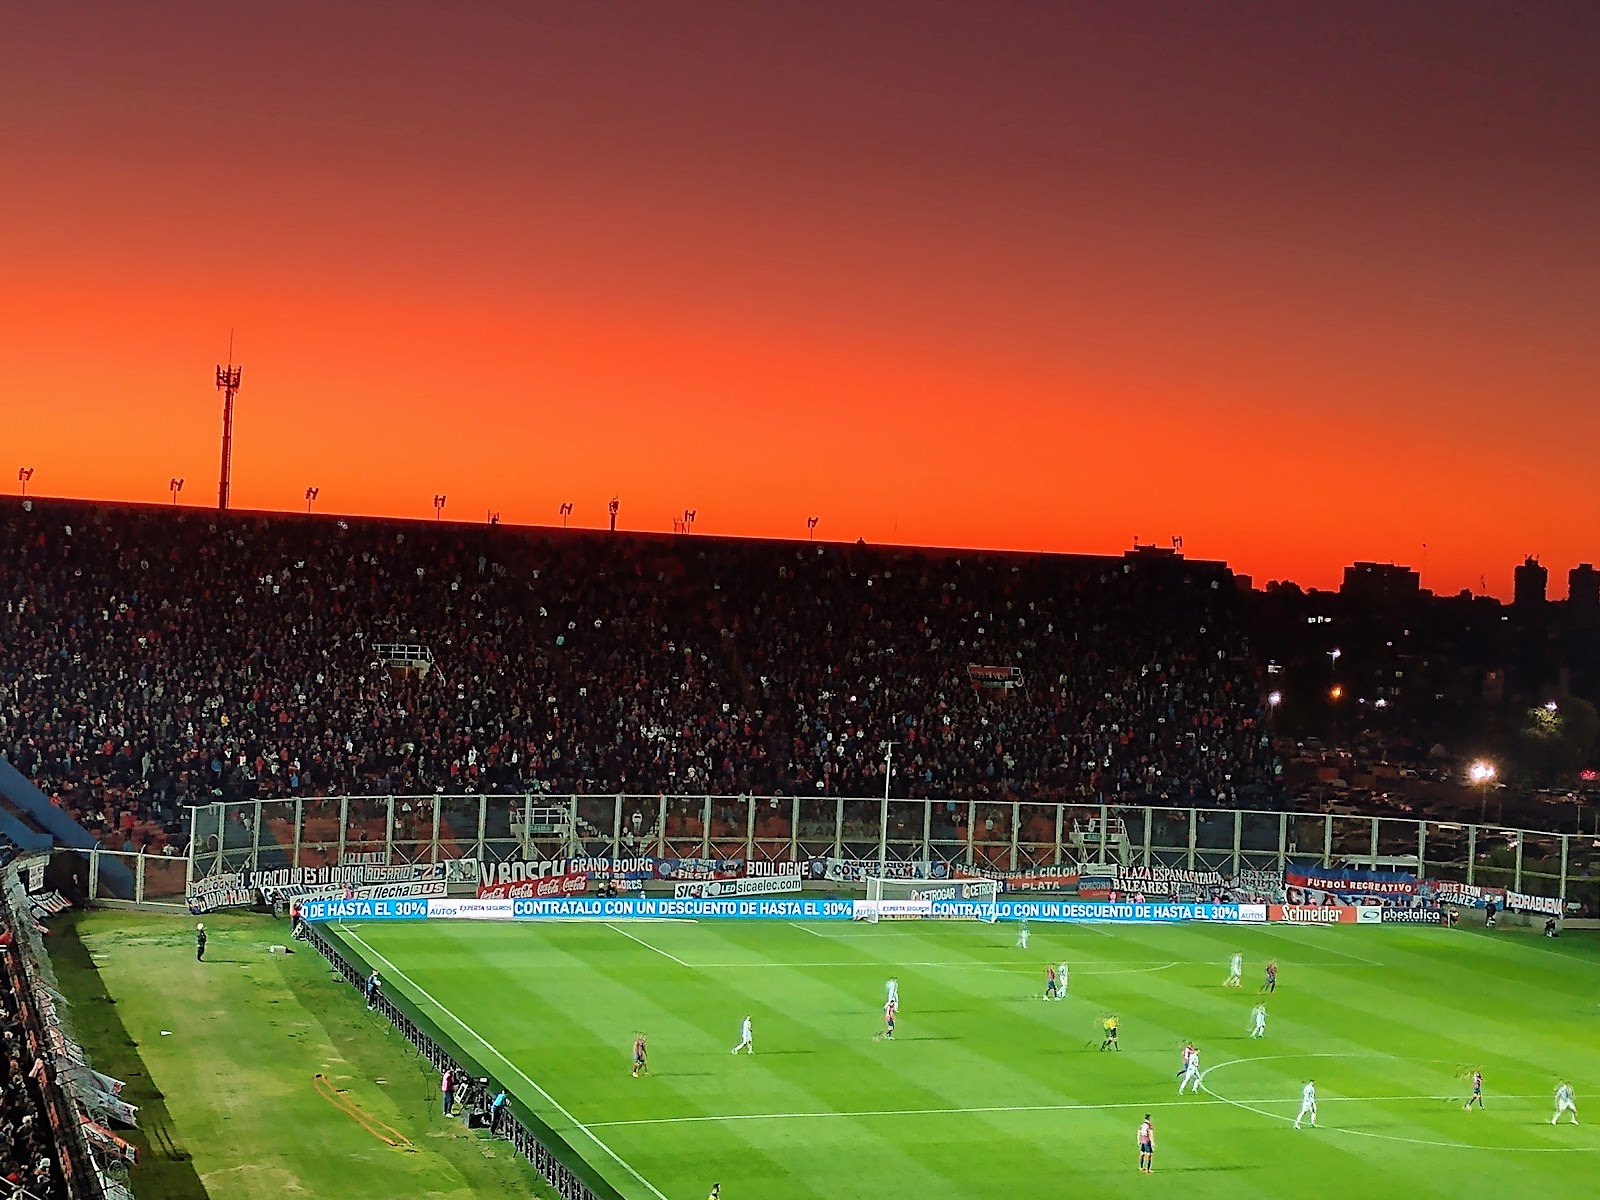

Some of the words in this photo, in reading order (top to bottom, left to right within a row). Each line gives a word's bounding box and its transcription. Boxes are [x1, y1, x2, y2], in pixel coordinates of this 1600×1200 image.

[410, 863, 444, 881] EZE
[571, 858, 609, 873] GRAND
[613, 859, 653, 872] BOURG
[746, 861, 809, 876] BOULOGNE
[1119, 865, 1151, 880] PLAZA
[236, 872, 246, 889] EL
[248, 868, 289, 890] SILENCIO
[291, 867, 302, 885] NO
[304, 867, 317, 884] ES
[319, 866, 329, 884] MI
[331, 866, 363, 883] IDIOMA
[366, 867, 410, 881] ROSARIO
[1025, 870, 1037, 879] EL
[738, 880, 800, 893] sicaelec.com
[1021, 881, 1060, 890] PLATA
[1113, 879, 1169, 894] BALEARES
[1307, 878, 1346, 889] FUTBOL
[1350, 882, 1411, 892] RECREATIVO
[1437, 882, 1459, 893] JOSE
[310, 904, 324, 917] DE
[327, 902, 371, 916] HASTA
[375, 902, 391, 915] EL
[395, 902, 426, 916] 30%
[514, 901, 601, 915] CONTRATALO
[605, 901, 633, 915] CON
[636, 901, 656, 915] UN
[659, 901, 736, 915] DESCUENTO
[740, 902, 757, 915] DE
[760, 902, 802, 915] HASTA
[804, 902, 820, 915] EL
[823, 902, 852, 916] 30%
[1506, 891, 1563, 915] PIEDRABUENA
[933, 903, 1010, 917] CONTRATALO
[1013, 904, 1039, 917] CON
[1042, 904, 1060, 917] UN
[1062, 904, 1133, 918] DESCUENTO
[1135, 905, 1151, 918] DE
[1154, 905, 1193, 918] HASTA
[1194, 906, 1209, 919] EL
[1211, 906, 1238, 919] 30%
[1282, 905, 1342, 922] Schneider
[1383, 909, 1440, 920] pbestatica
